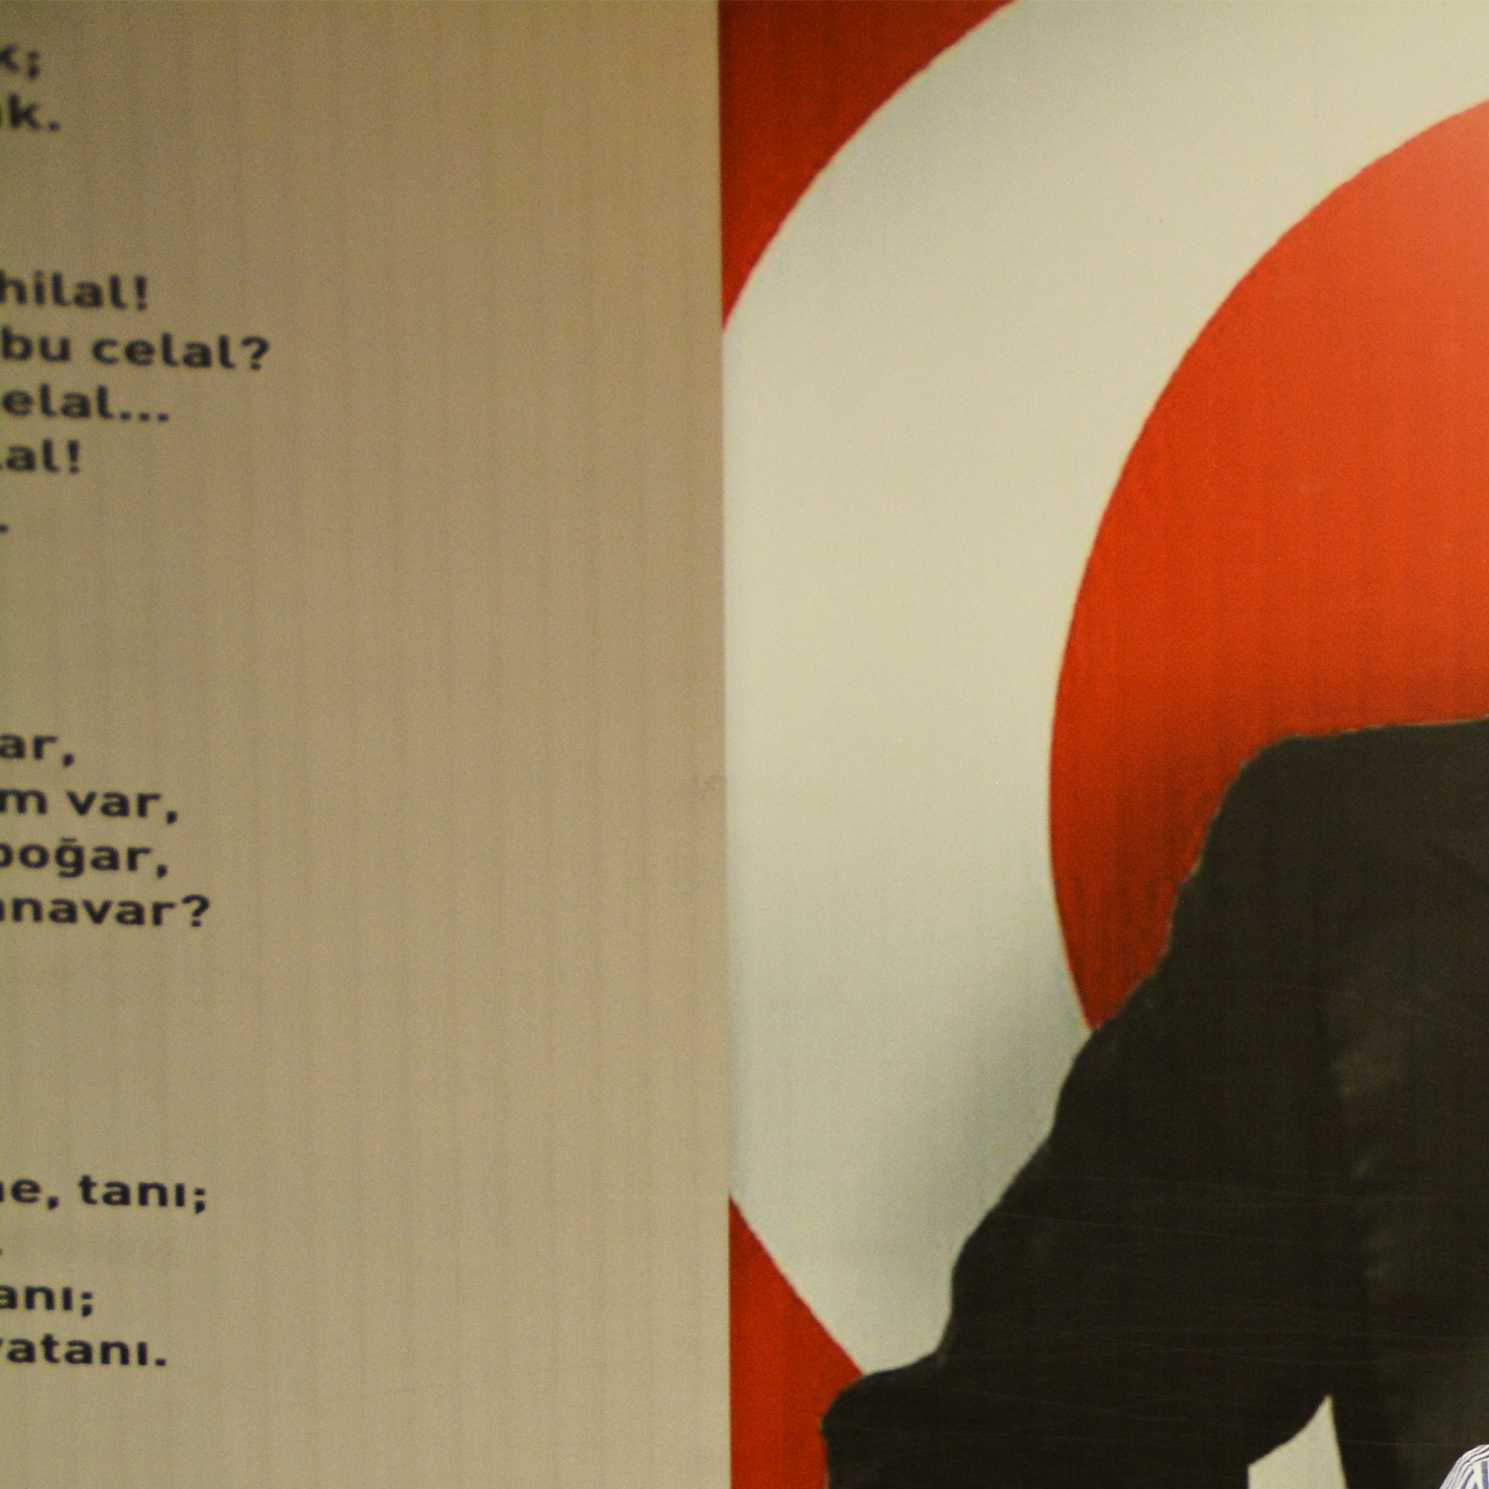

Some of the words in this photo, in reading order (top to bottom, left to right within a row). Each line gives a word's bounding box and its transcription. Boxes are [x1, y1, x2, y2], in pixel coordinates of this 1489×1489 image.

[0, 94, 60, 132] k.
[0, 326, 72, 362] bu
[91, 332, 270, 370] celal?
[0, 439, 81, 475] al!
[0, 733, 75, 768] ar,
[66, 790, 179, 825] var,
[0, 894, 211, 928] navar?
[0, 1178, 60, 1211] e,
[78, 1174, 207, 1215] tanı;
[0, 1333, 167, 1368] atanı.
